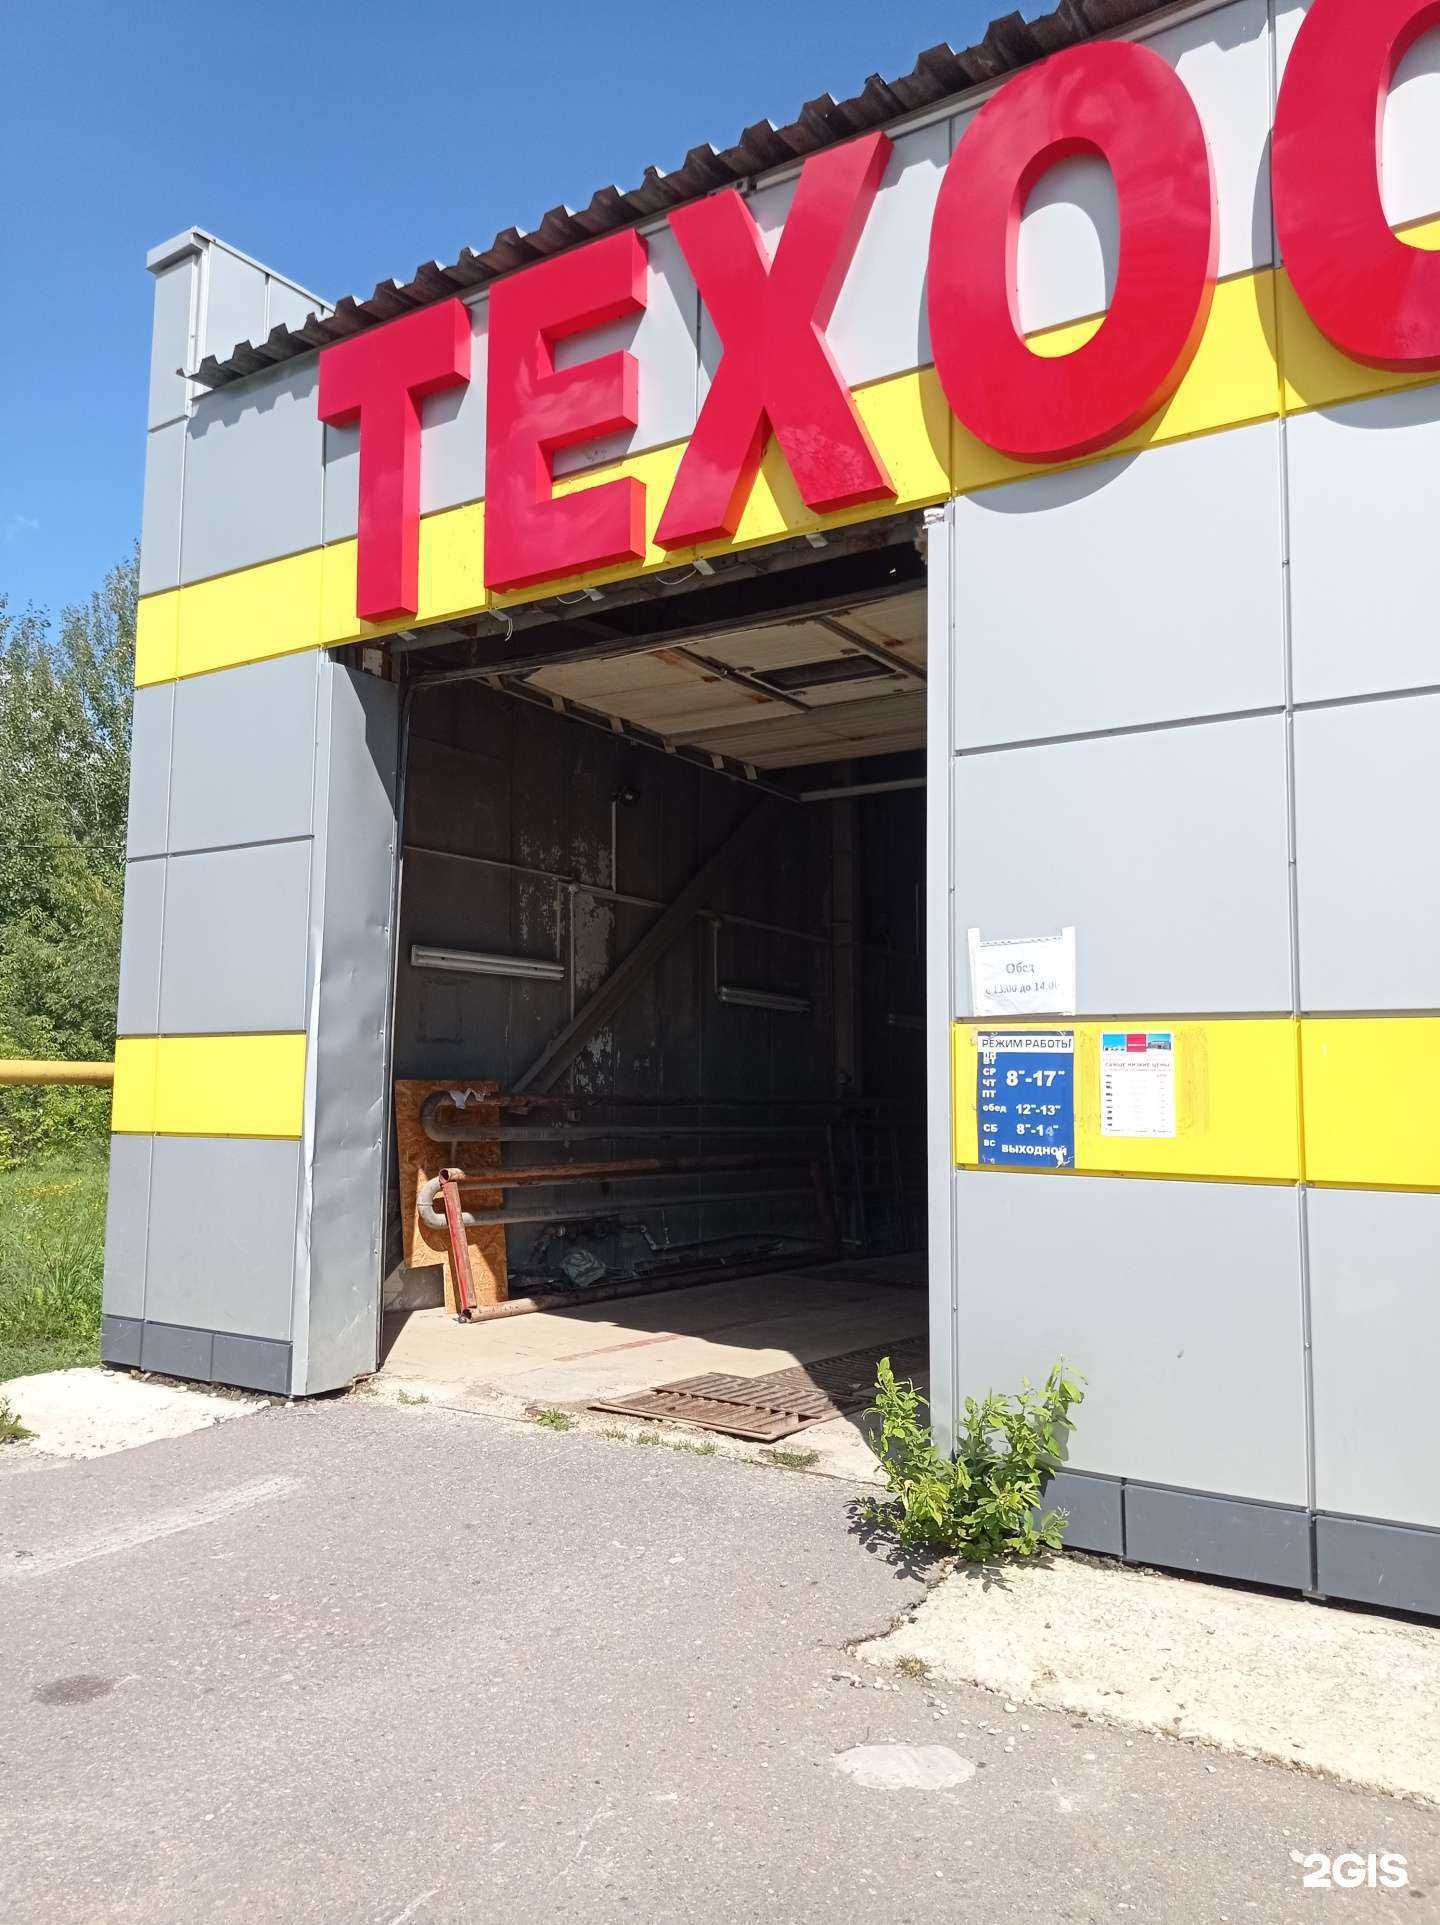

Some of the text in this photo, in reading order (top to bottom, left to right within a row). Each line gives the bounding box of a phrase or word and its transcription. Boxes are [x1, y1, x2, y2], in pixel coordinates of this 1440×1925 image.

[1020, 984, 1031, 994] до
[982, 1038, 1072, 1049] РЕЖИМ РАБОТЫ
[983, 1067, 997, 1076] СР
[982, 1078, 997, 1087] ЧТ
[982, 1089, 997, 1098] ПТ
[982, 1104, 1007, 1113] обед
[983, 1123, 998, 1133] СБ
